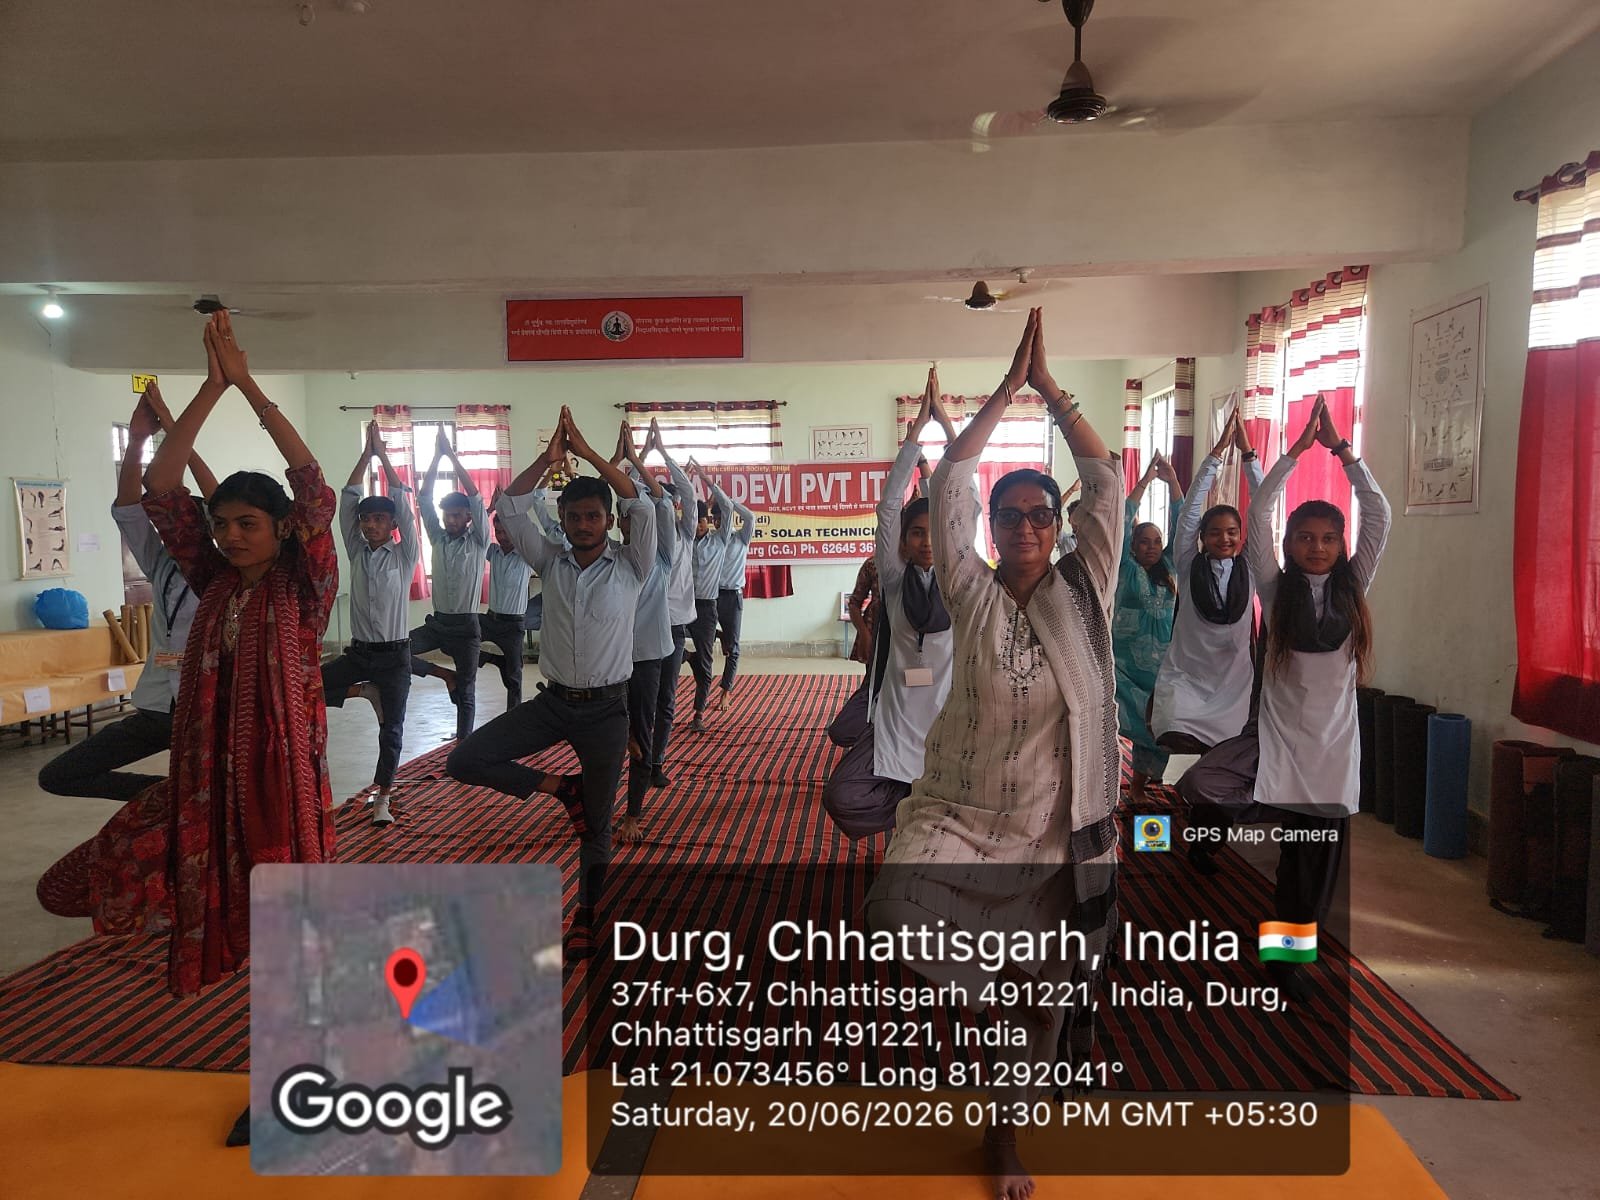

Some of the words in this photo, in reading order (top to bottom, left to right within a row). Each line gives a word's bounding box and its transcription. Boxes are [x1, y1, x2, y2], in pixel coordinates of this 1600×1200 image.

[731, 473, 791, 505] DEVI
[801, 472, 852, 504] PVT
[771, 528, 812, 538] SOLAR
[748, 546, 764, 557] urg
[768, 544, 797, 557] (C.G.)
[800, 543, 818, 554] Ph.
[821, 543, 857, 554] 62645
